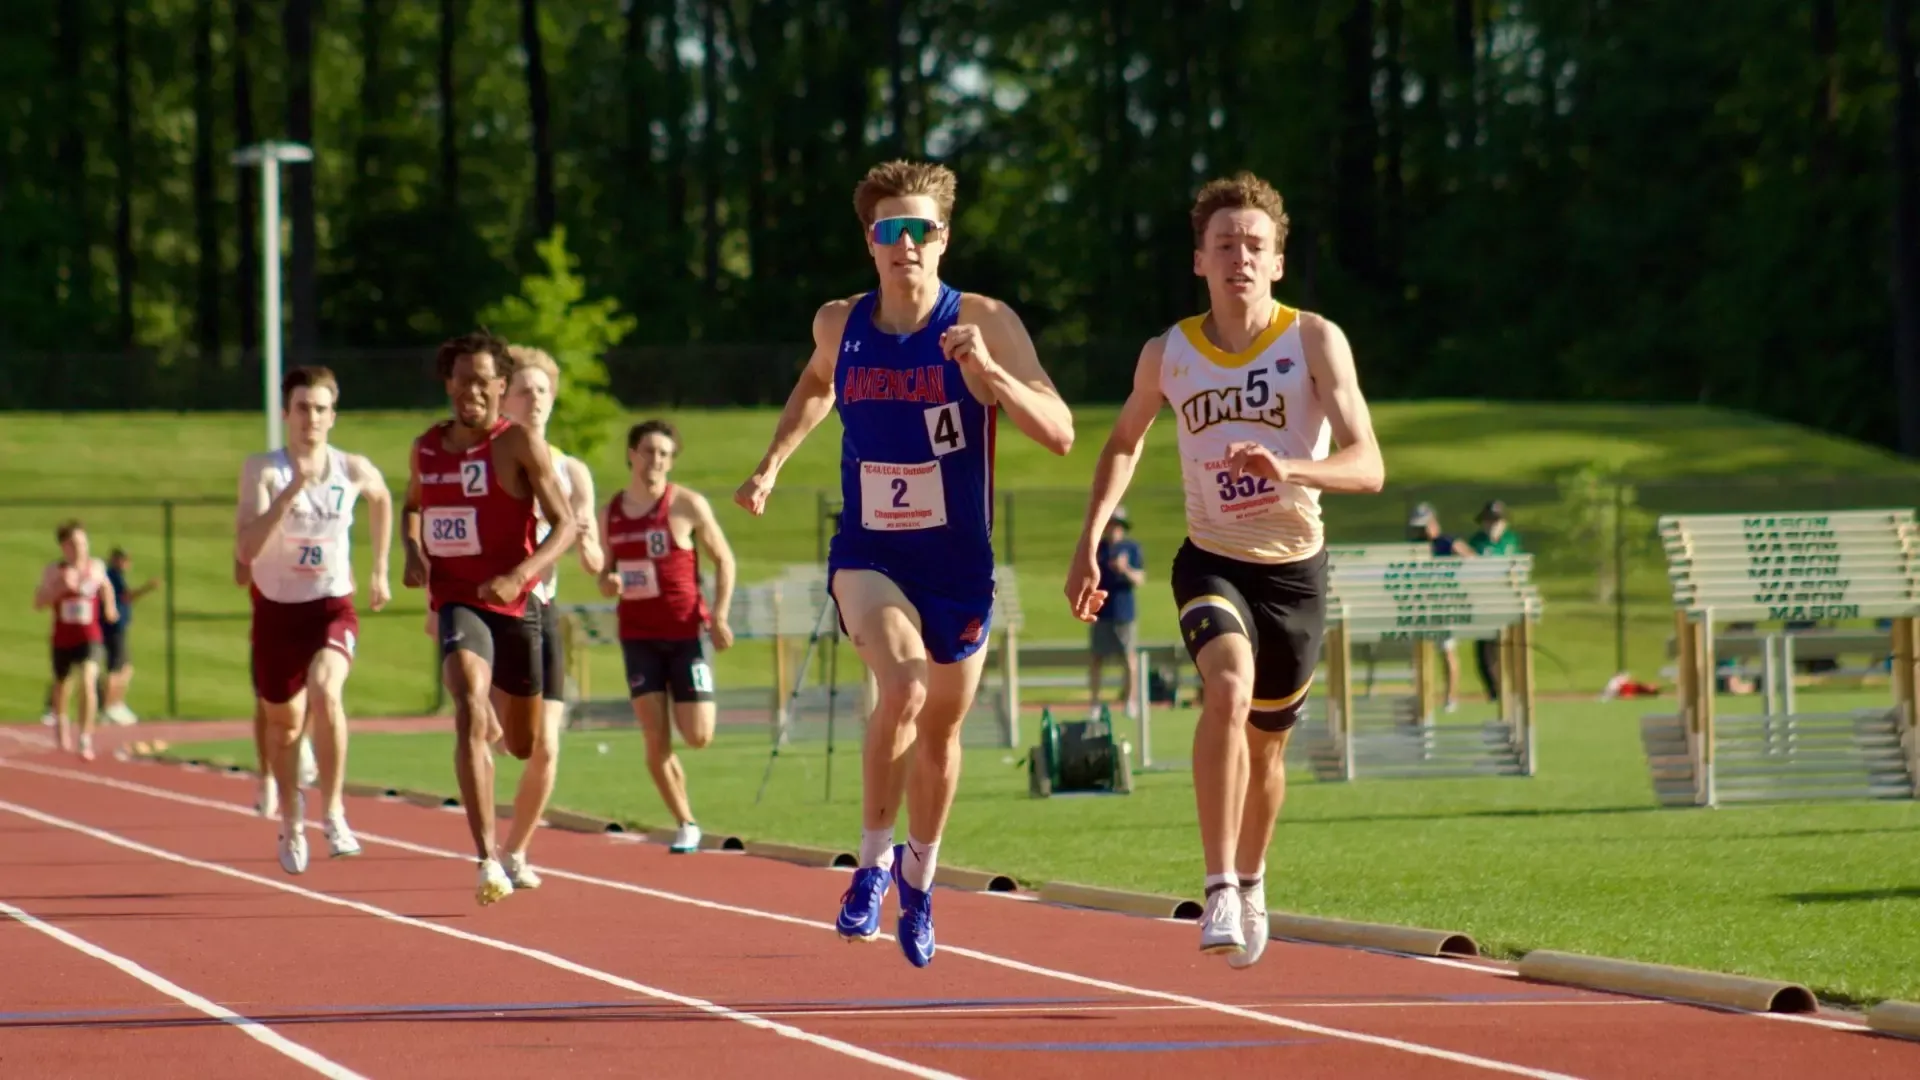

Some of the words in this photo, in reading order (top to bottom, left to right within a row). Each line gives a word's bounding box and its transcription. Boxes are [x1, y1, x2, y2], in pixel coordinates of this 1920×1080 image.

[844, 365, 946, 404] AMERICAN
[1246, 368, 1269, 408] 5
[1182, 387, 1286, 434] UMC
[934, 407, 959, 448] 4
[464, 464, 483, 494] 2
[891, 478, 910, 508] 2
[1216, 471, 1275, 501] 352
[331, 485, 344, 511] 7
[1220, 495, 1280, 513] Championships
[874, 509, 933, 520] Championships
[433, 518, 467, 540] 326
[650, 532, 665, 555] 8
[1397, 614, 1472, 627] MASON
[1768, 604, 1859, 619] MASON
